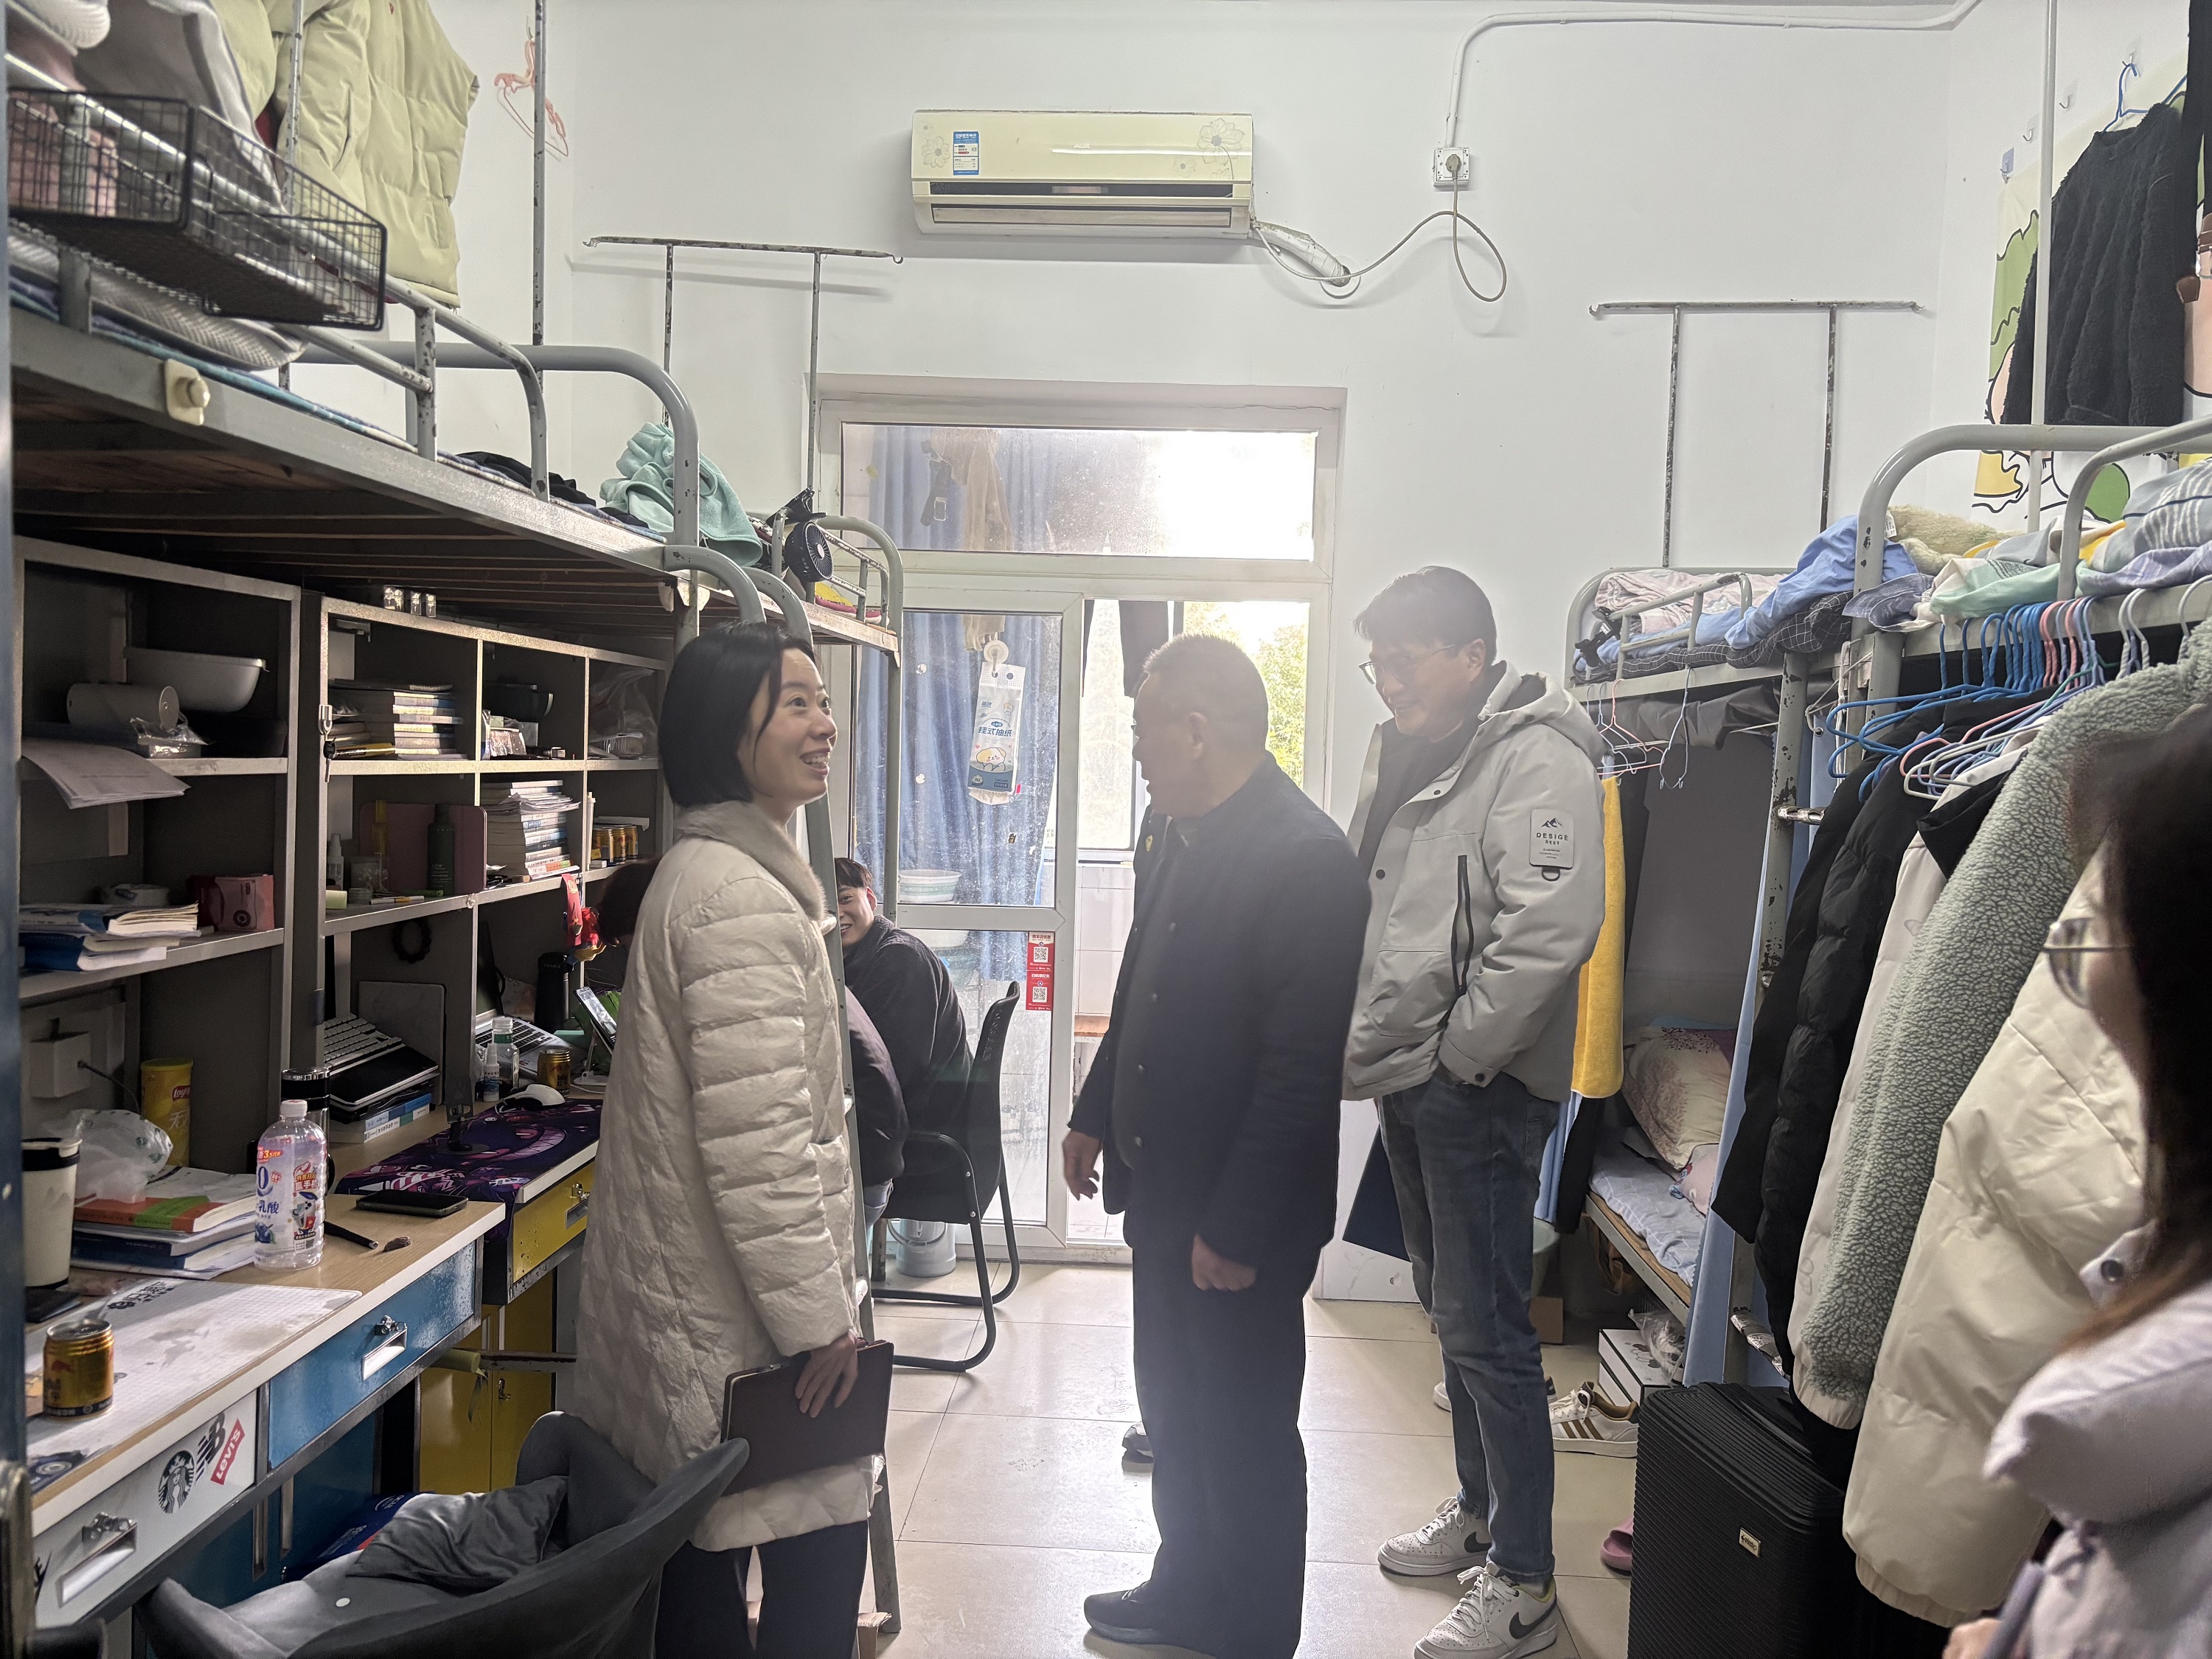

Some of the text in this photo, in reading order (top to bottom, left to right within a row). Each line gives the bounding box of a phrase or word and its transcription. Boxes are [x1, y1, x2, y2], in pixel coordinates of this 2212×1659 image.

[978, 726, 1012, 737] 挂式抽纸
[256, 1200, 279, 1214] 乳酸
